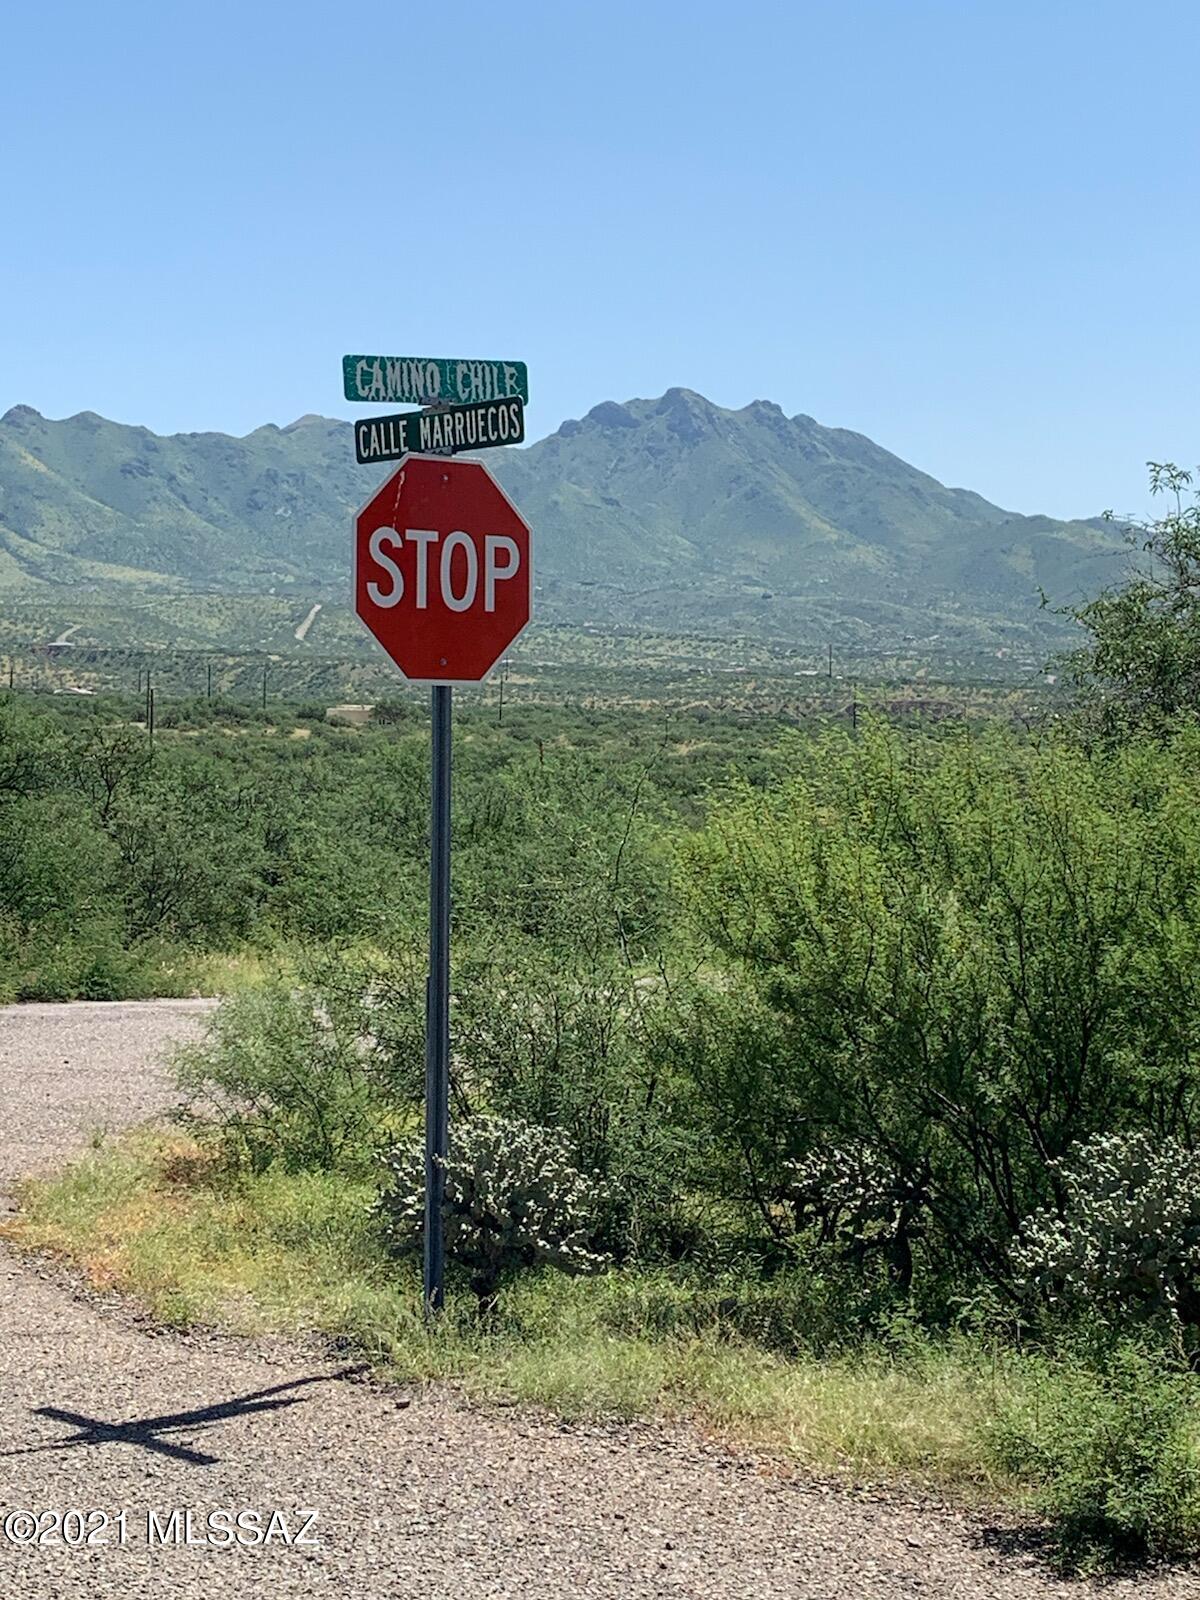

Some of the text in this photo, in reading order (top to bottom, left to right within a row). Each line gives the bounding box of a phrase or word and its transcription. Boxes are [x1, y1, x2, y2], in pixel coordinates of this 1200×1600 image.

[355, 359, 521, 400] CAMINO CHILE
[359, 403, 521, 458] CALLE MARRUECOS
[366, 526, 520, 612] STOP
